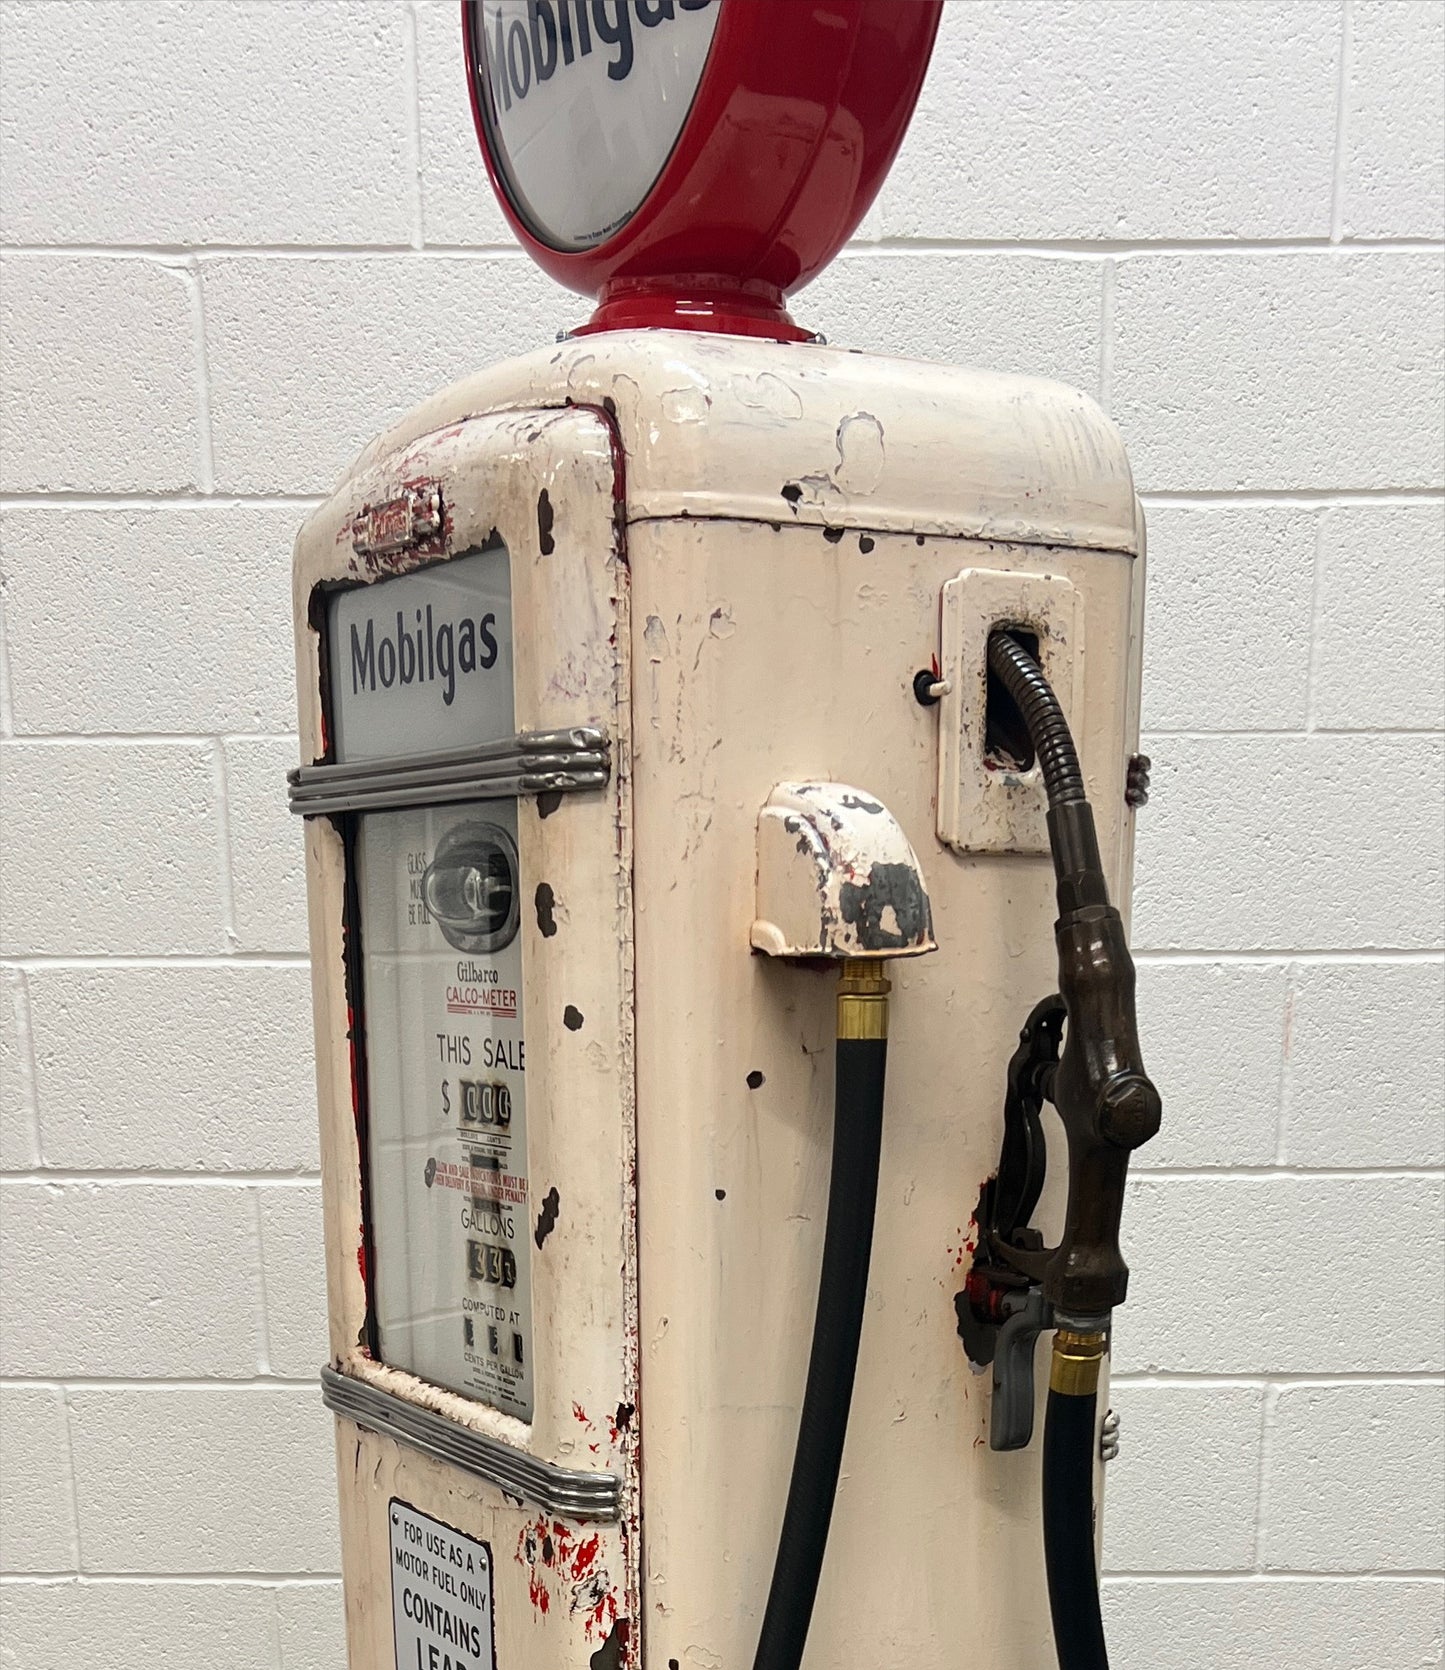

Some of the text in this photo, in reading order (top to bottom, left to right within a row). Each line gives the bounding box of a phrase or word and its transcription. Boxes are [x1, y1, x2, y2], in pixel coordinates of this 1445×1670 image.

[350, 604, 499, 706] Mobilgas
[457, 961, 499, 984] Gilbarco
[446, 986, 517, 1007] CALCO-METER
[436, 1034, 525, 1072] THIS SALE
[461, 1208, 515, 1239] GALLONS
[462, 1297, 521, 1325] COMPUTED AT
[404, 1520, 475, 1575] FOR USE AS A
[395, 1546, 487, 1611] MOTOR FUEL ONLY
[403, 1587, 481, 1658] CONTAINS
